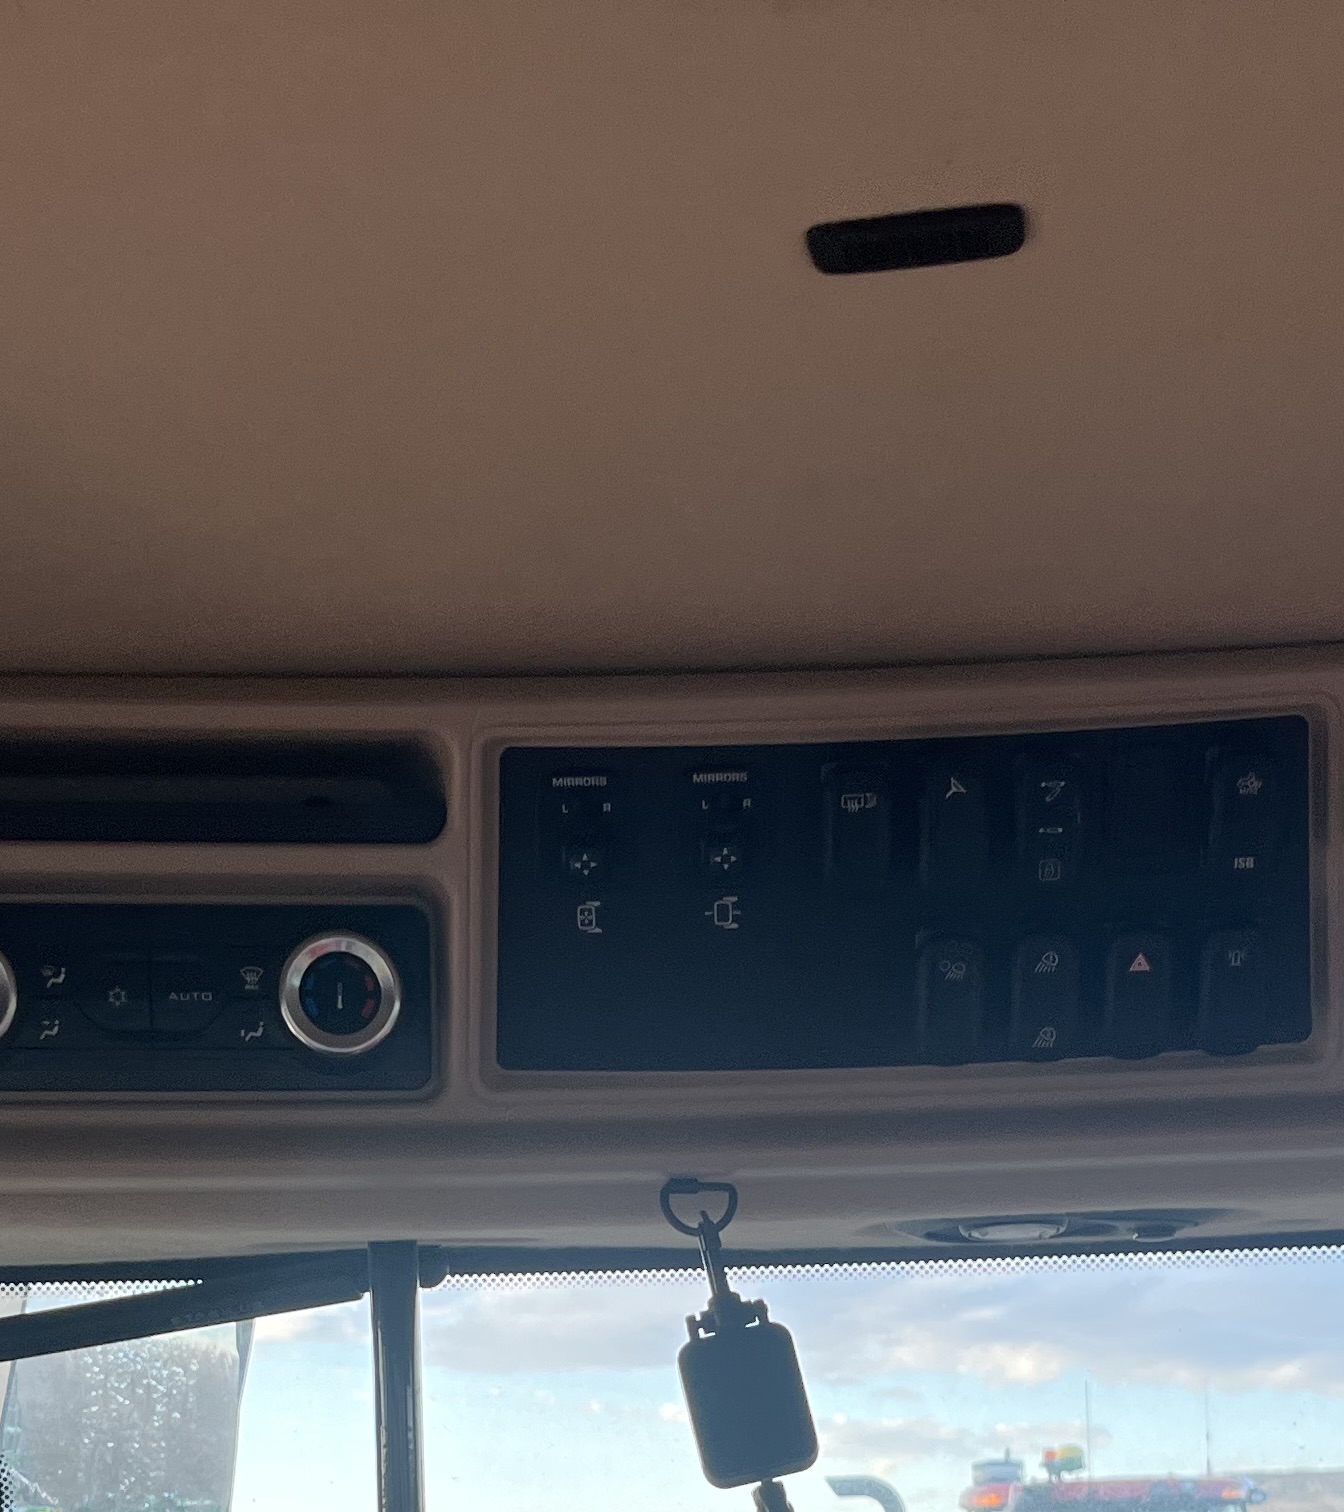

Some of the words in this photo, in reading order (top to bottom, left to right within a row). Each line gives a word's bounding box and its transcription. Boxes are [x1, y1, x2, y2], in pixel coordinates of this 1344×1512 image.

[552, 775, 608, 788] MIRRORS
[692, 771, 748, 784] MIRRORS
[168, 991, 213, 1001] AUTO
